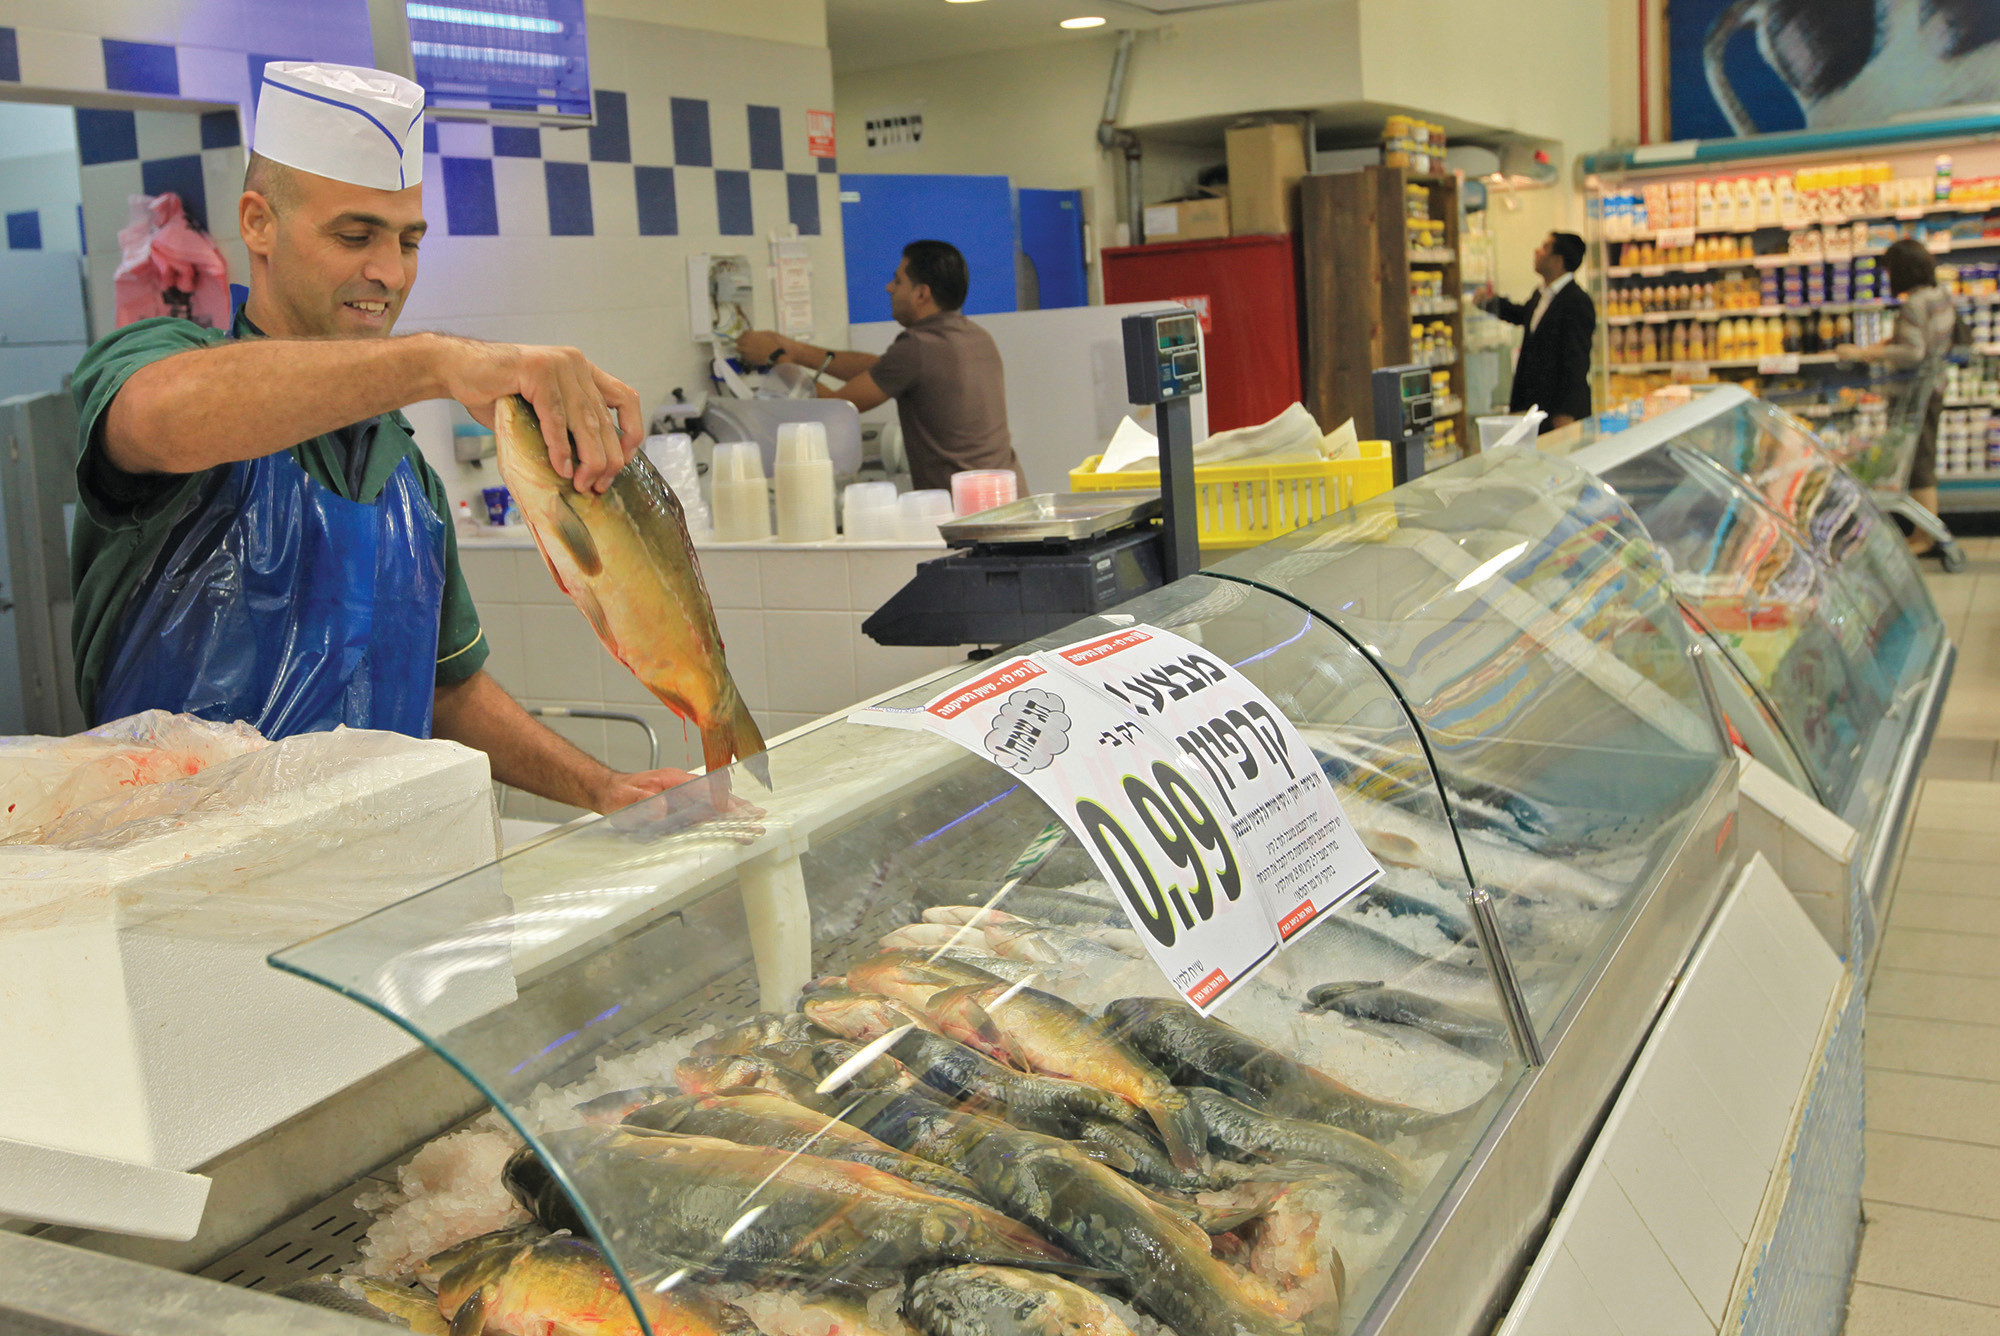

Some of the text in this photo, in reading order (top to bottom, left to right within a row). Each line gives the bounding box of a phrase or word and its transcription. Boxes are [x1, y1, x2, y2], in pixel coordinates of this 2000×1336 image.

[999, 673, 1016, 684] לוי
[1011, 666, 1031, 679] רמי
[972, 682, 997, 698] שיווק
[1103, 654, 1227, 716] מבצע!
[937, 692, 978, 716] השיקמה
[1022, 700, 1052, 723] חג
[995, 718, 1042, 762] שמח!
[1098, 721, 1145, 747] רק ב-
[1175, 701, 1295, 817] קרפיון
